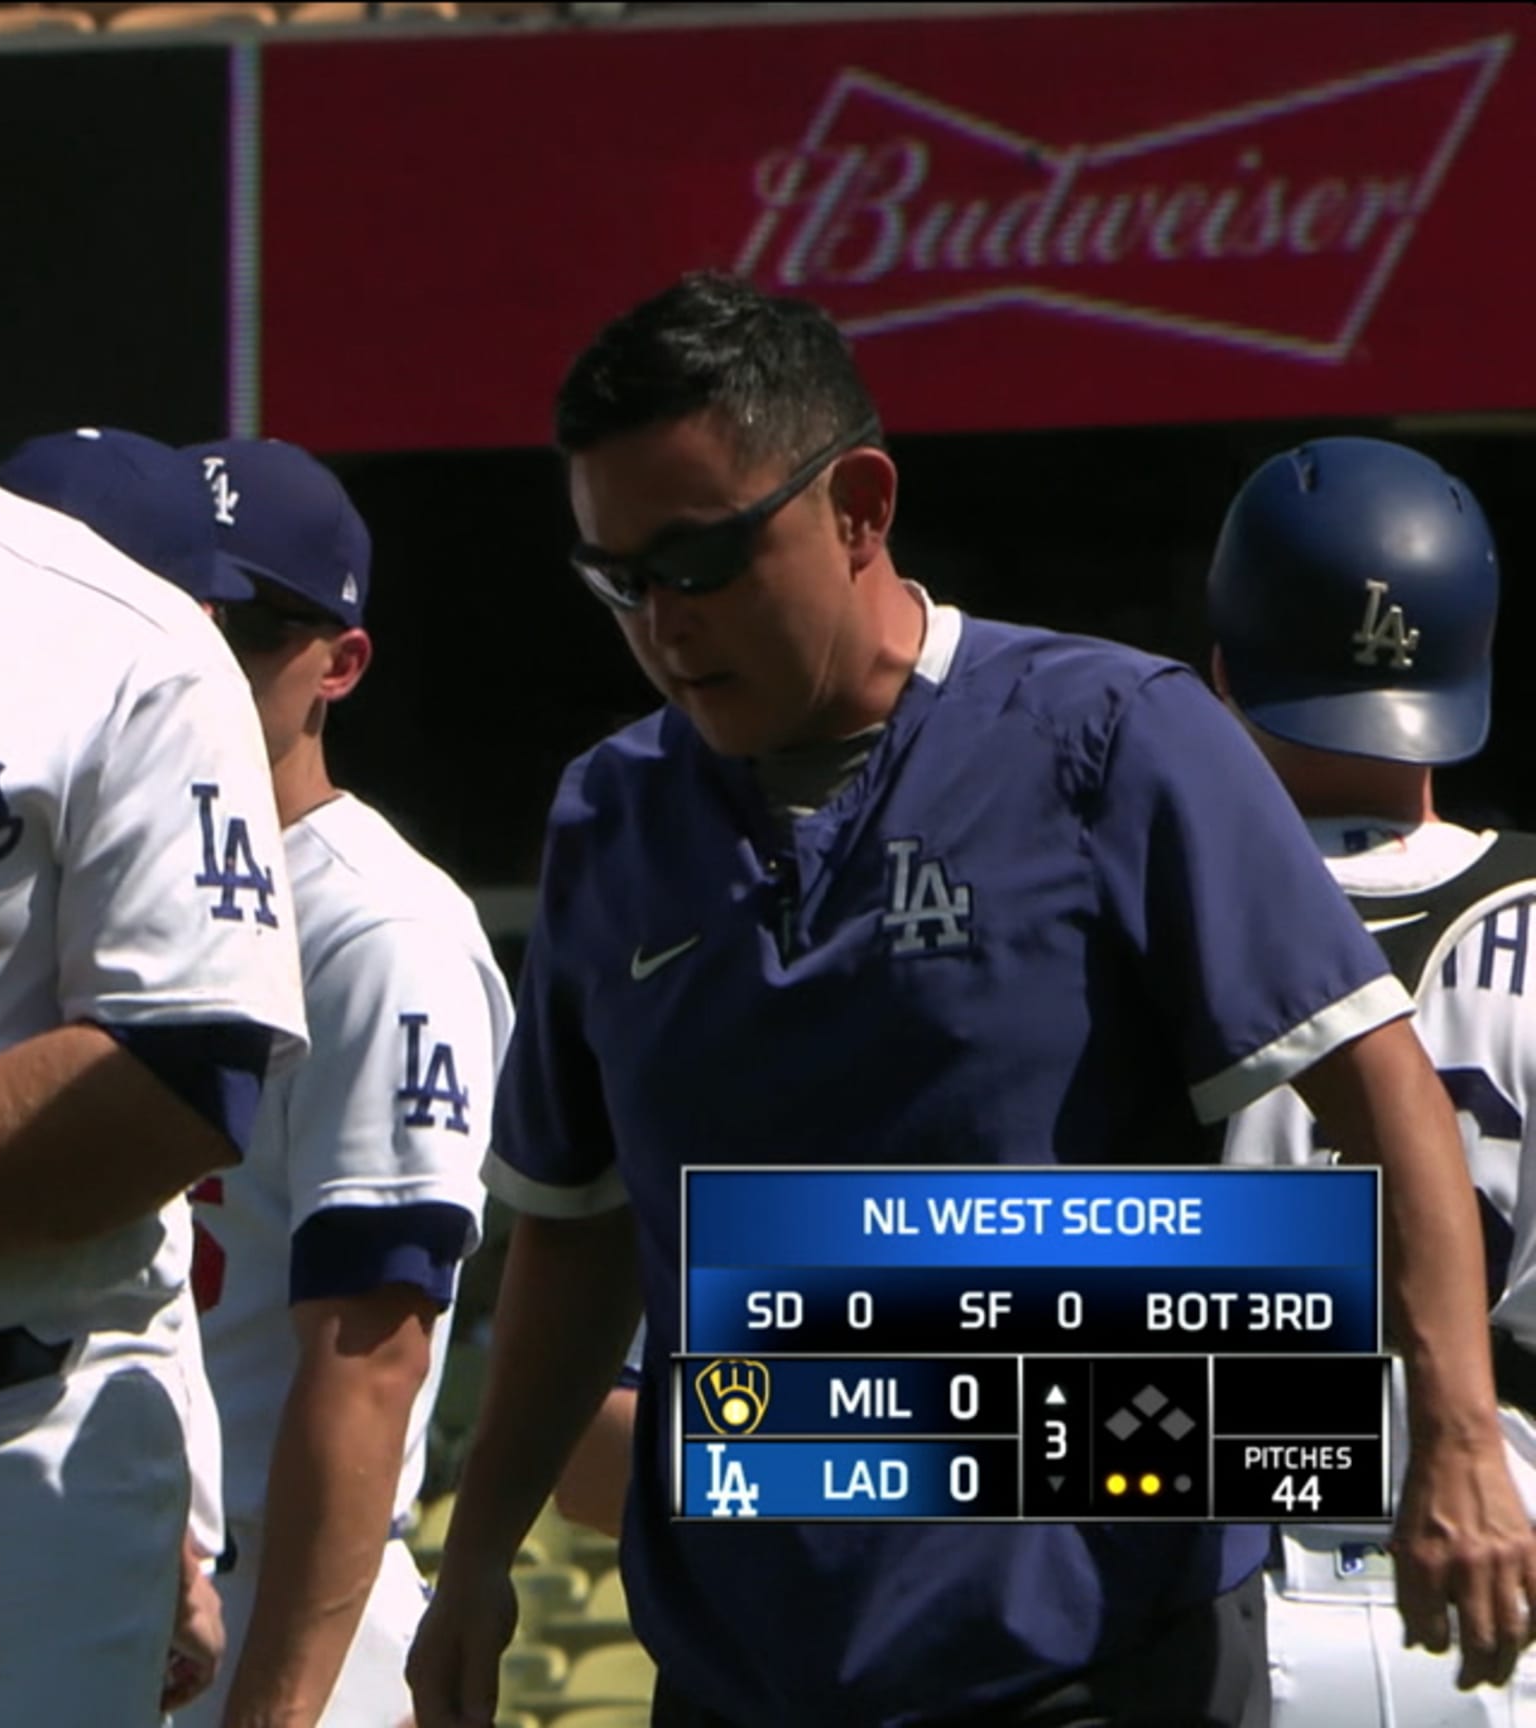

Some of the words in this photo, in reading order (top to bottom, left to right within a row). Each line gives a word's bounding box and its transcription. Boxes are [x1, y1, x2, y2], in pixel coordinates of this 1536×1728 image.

[754, 138, 1414, 287] Budweiser
[1353, 579, 1420, 668] LA
[191, 783, 279, 929] LA
[883, 840, 970, 955] LA
[397, 1013, 470, 1135] LA
